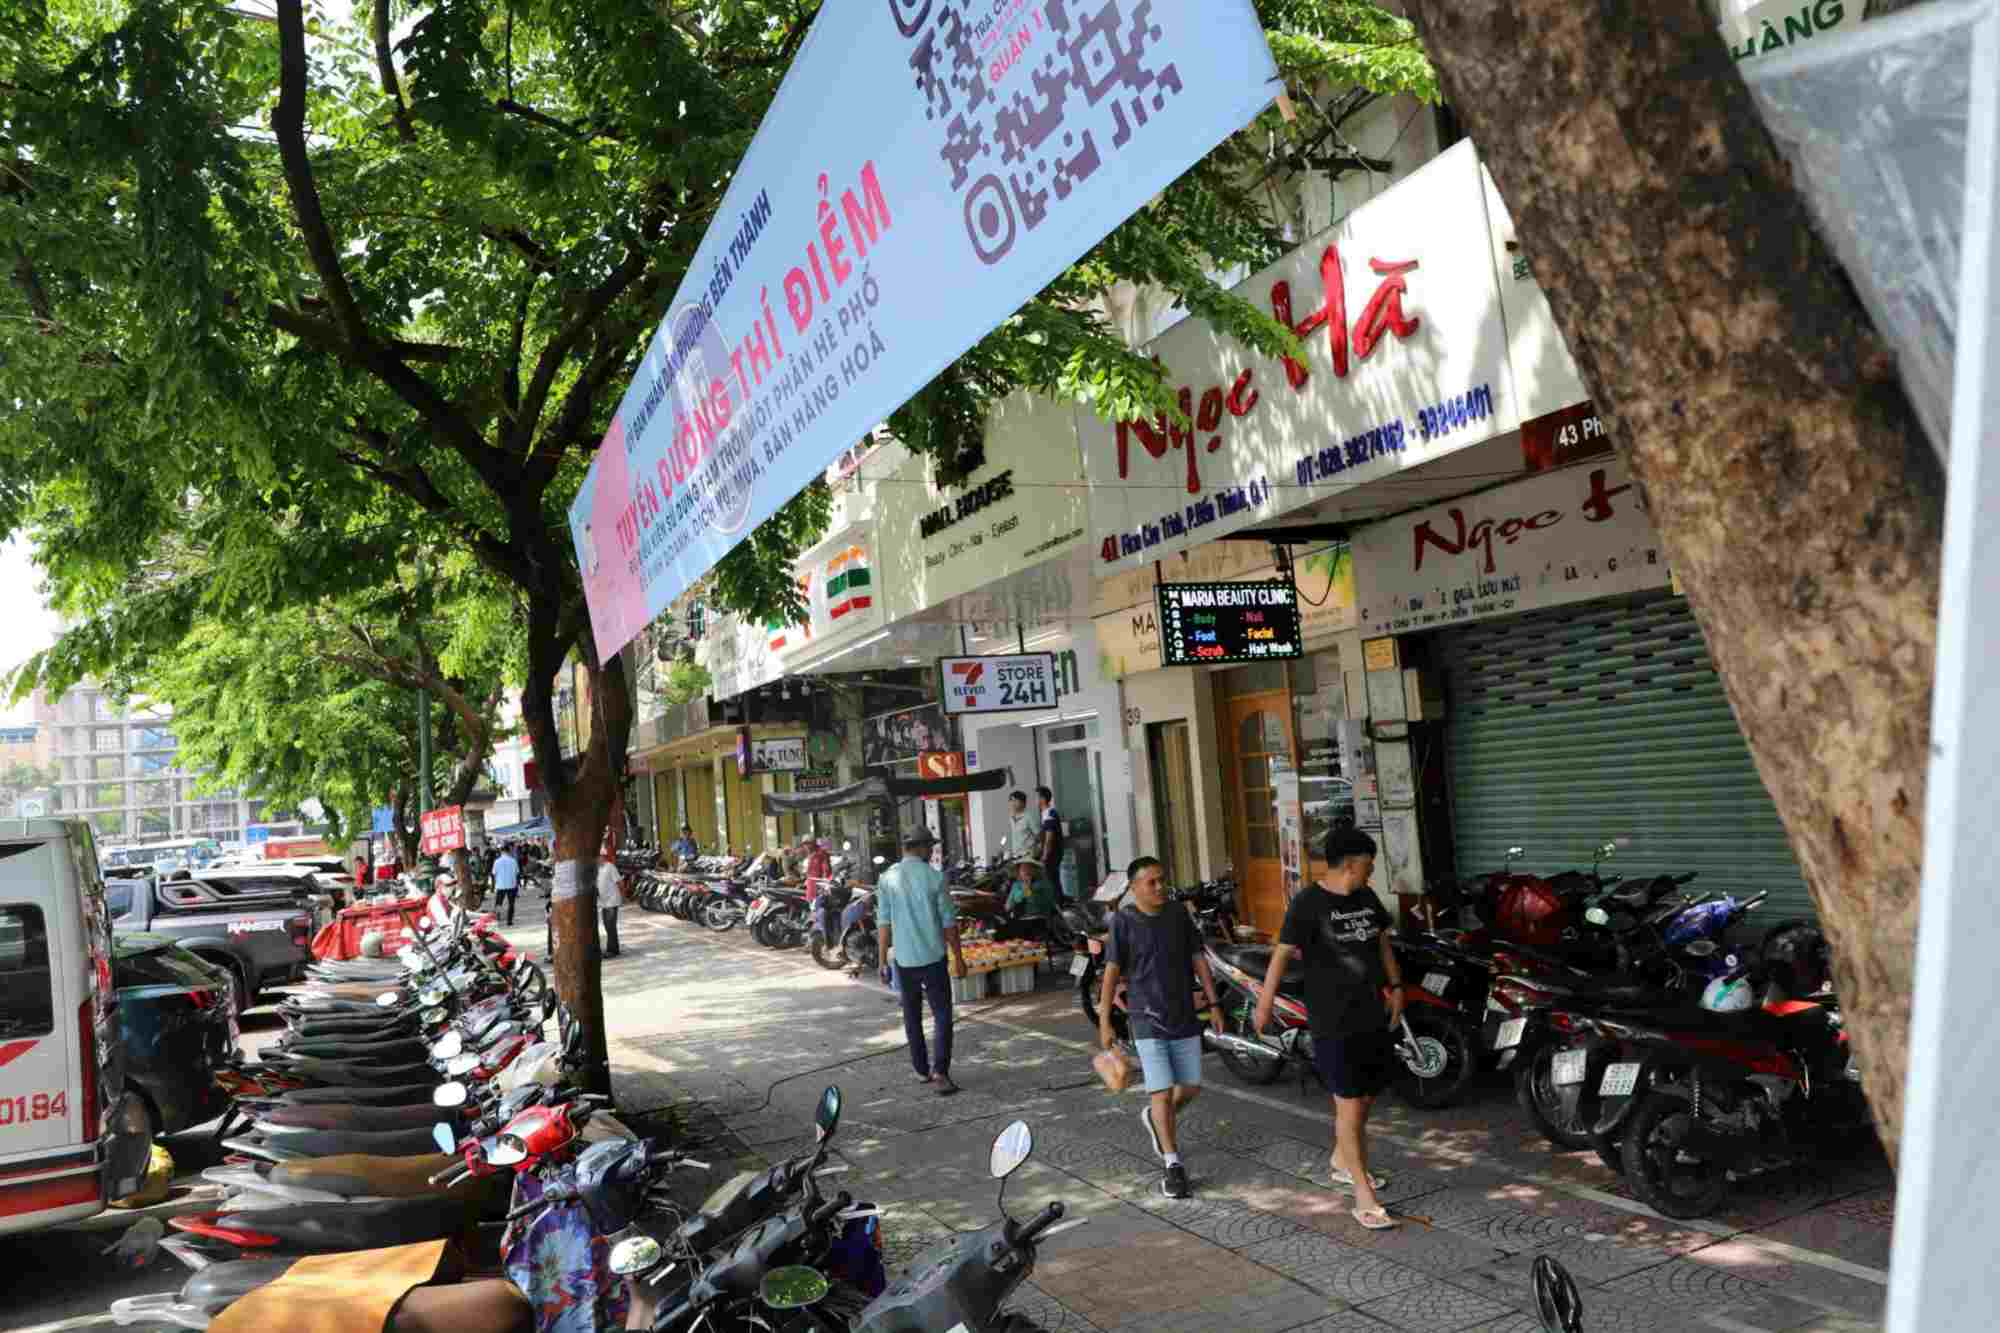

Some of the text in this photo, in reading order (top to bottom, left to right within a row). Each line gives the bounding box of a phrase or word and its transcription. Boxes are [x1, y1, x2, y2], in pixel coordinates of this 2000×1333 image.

[730, 187, 772, 273] THÀNH
[729, 281, 784, 407] THÍ
[781, 154, 891, 340] ĐIỂM
[837, 260, 883, 338] PHỐ
[1559, 416, 1606, 447] 43 Ph
[1413, 508, 1565, 574] Ngọc
[1182, 588, 1292, 607] MARIA BEAUTY CLINIC
[1132, 612, 1156, 637] MA
[997, 666, 1044, 682] STORE
[999, 681, 1048, 705] 24H
